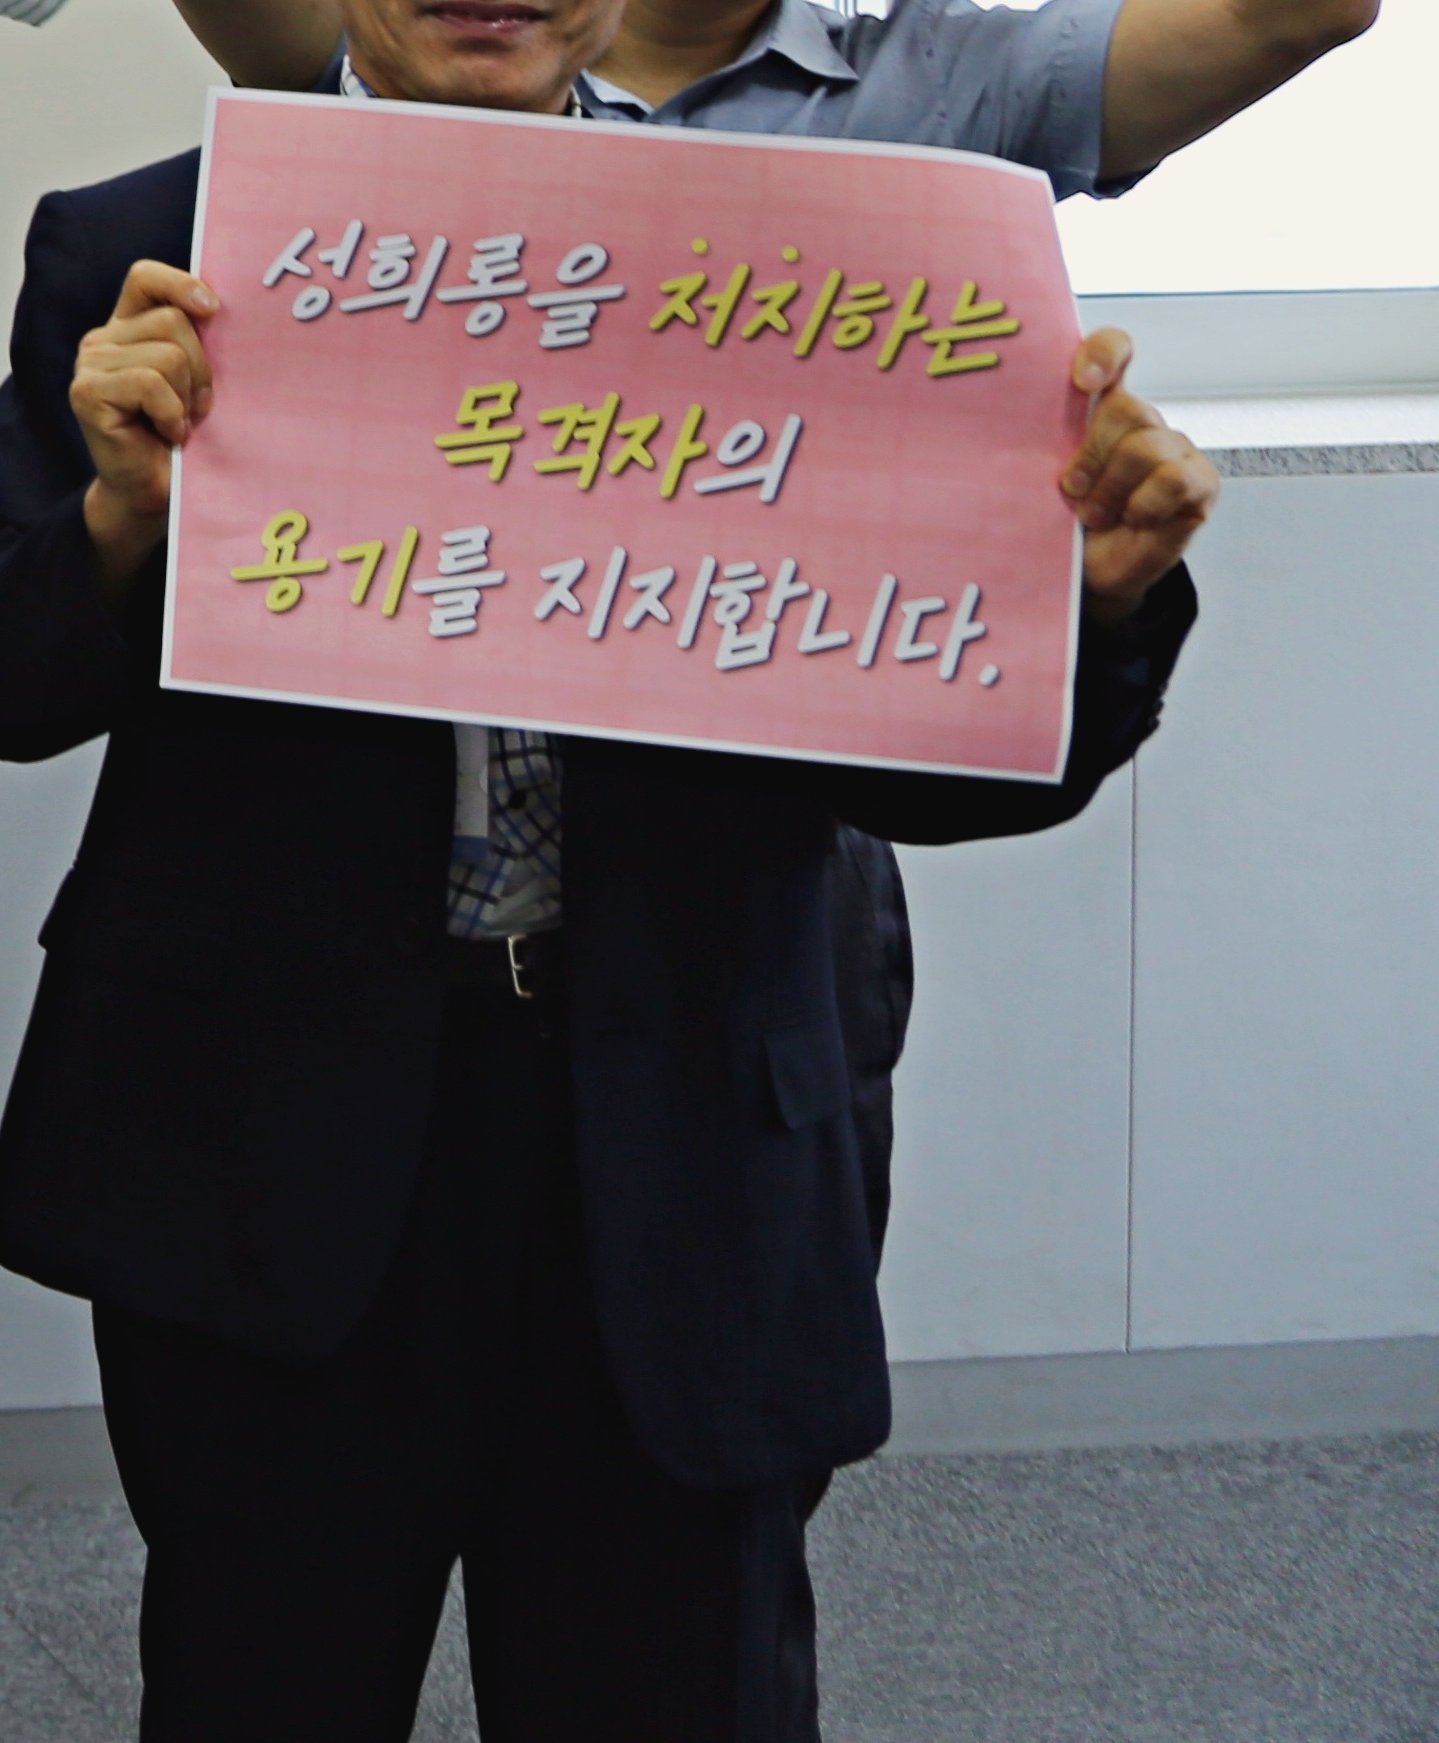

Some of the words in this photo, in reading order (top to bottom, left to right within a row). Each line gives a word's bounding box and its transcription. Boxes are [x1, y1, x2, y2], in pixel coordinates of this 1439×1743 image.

[262, 219, 626, 349] 성희롱을
[649, 262, 1021, 378] 저지하는
[434, 381, 802, 503] 목격자의
[230, 510, 506, 638] 용기를
[534, 546, 1001, 686] 지지합니다.
